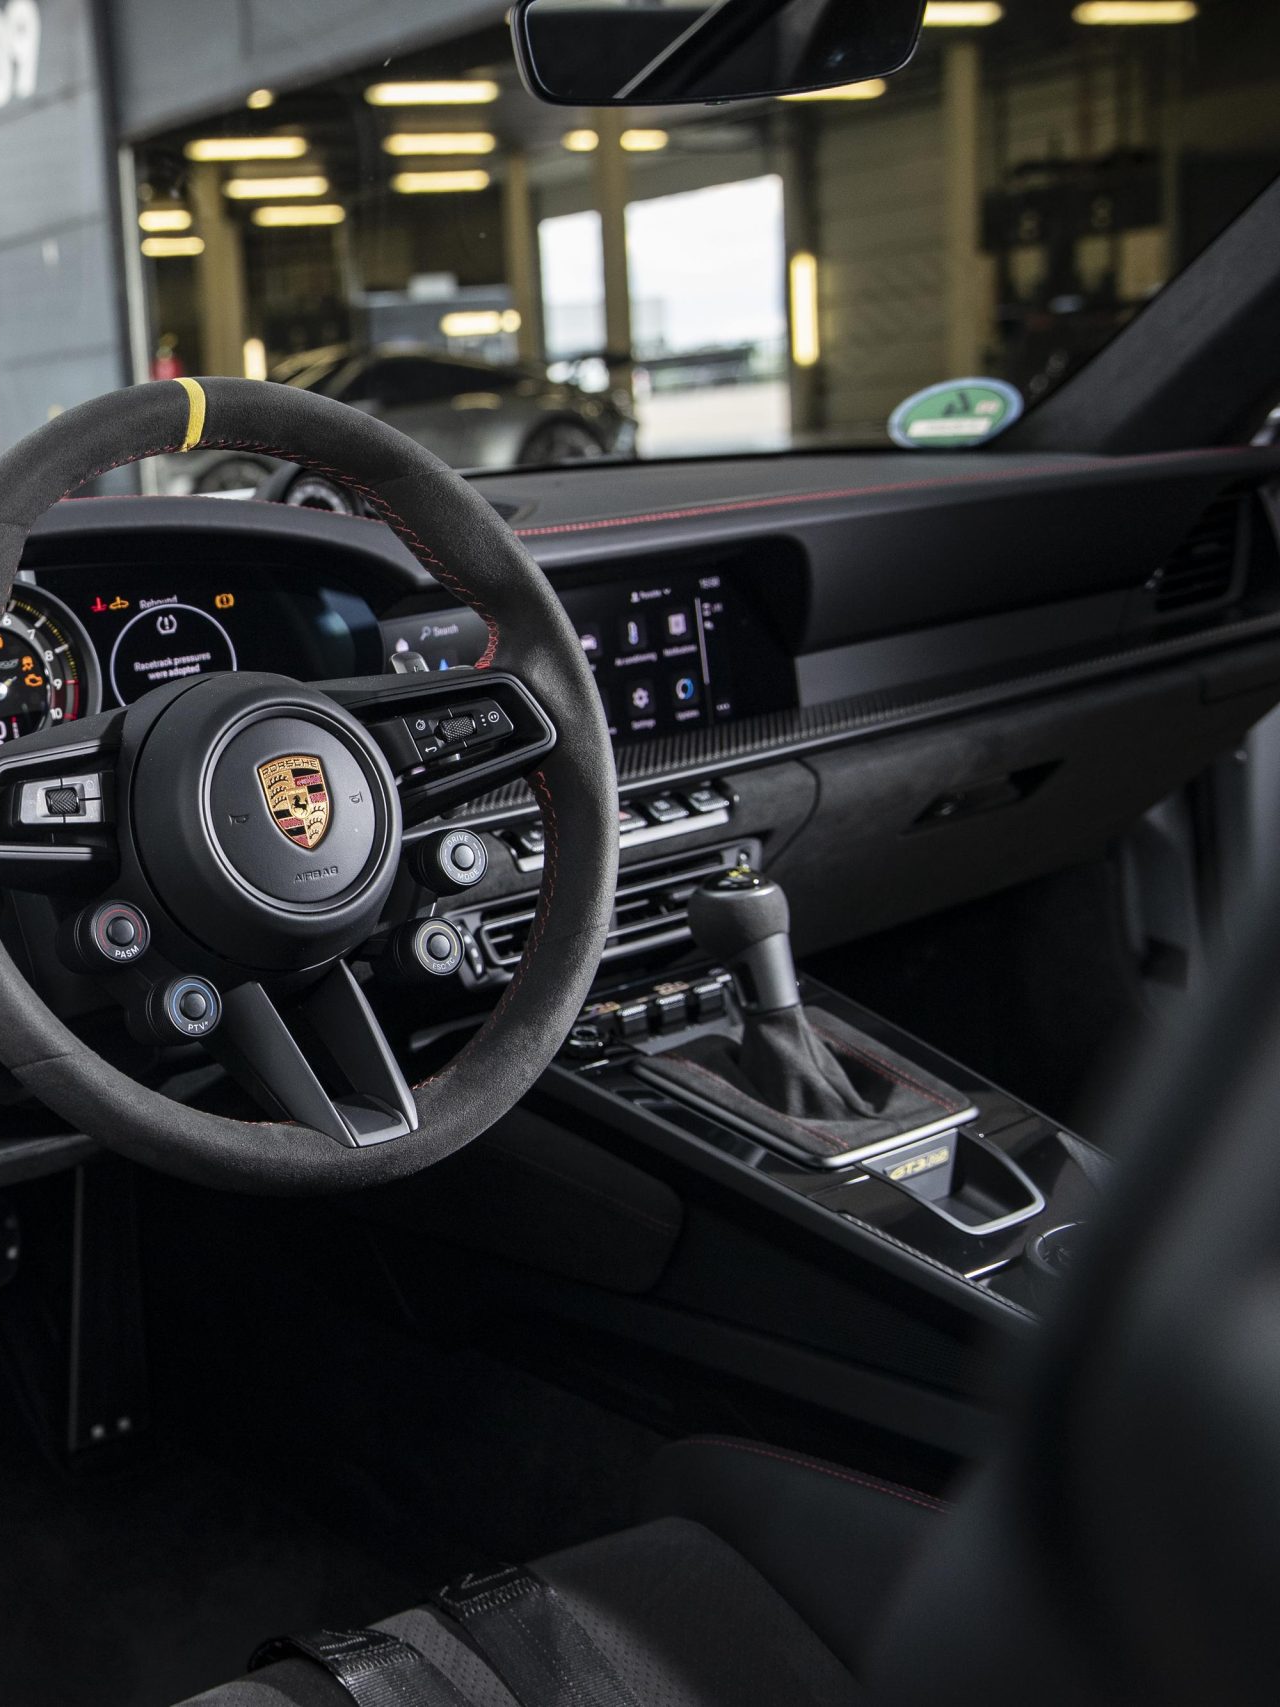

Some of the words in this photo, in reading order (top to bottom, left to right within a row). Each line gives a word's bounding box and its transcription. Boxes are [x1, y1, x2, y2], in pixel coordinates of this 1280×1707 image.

[1, 613, 12, 627] 6
[27, 628, 37, 641] 7
[44, 650, 54, 662] 8
[133, 657, 173, 672] Racetrack
[173, 652, 211, 666] pressures
[147, 669, 168, 681] were
[168, 663, 200, 677] adopted
[52, 678, 62, 690] 9
[50, 707, 63, 720] 10
[261, 758, 319, 777] PORSCHE
[447, 834, 469, 847] DRIVE
[293, 865, 339, 884] AIRBAG
[457, 868, 480, 881] MODE
[115, 945, 140, 958] PASM
